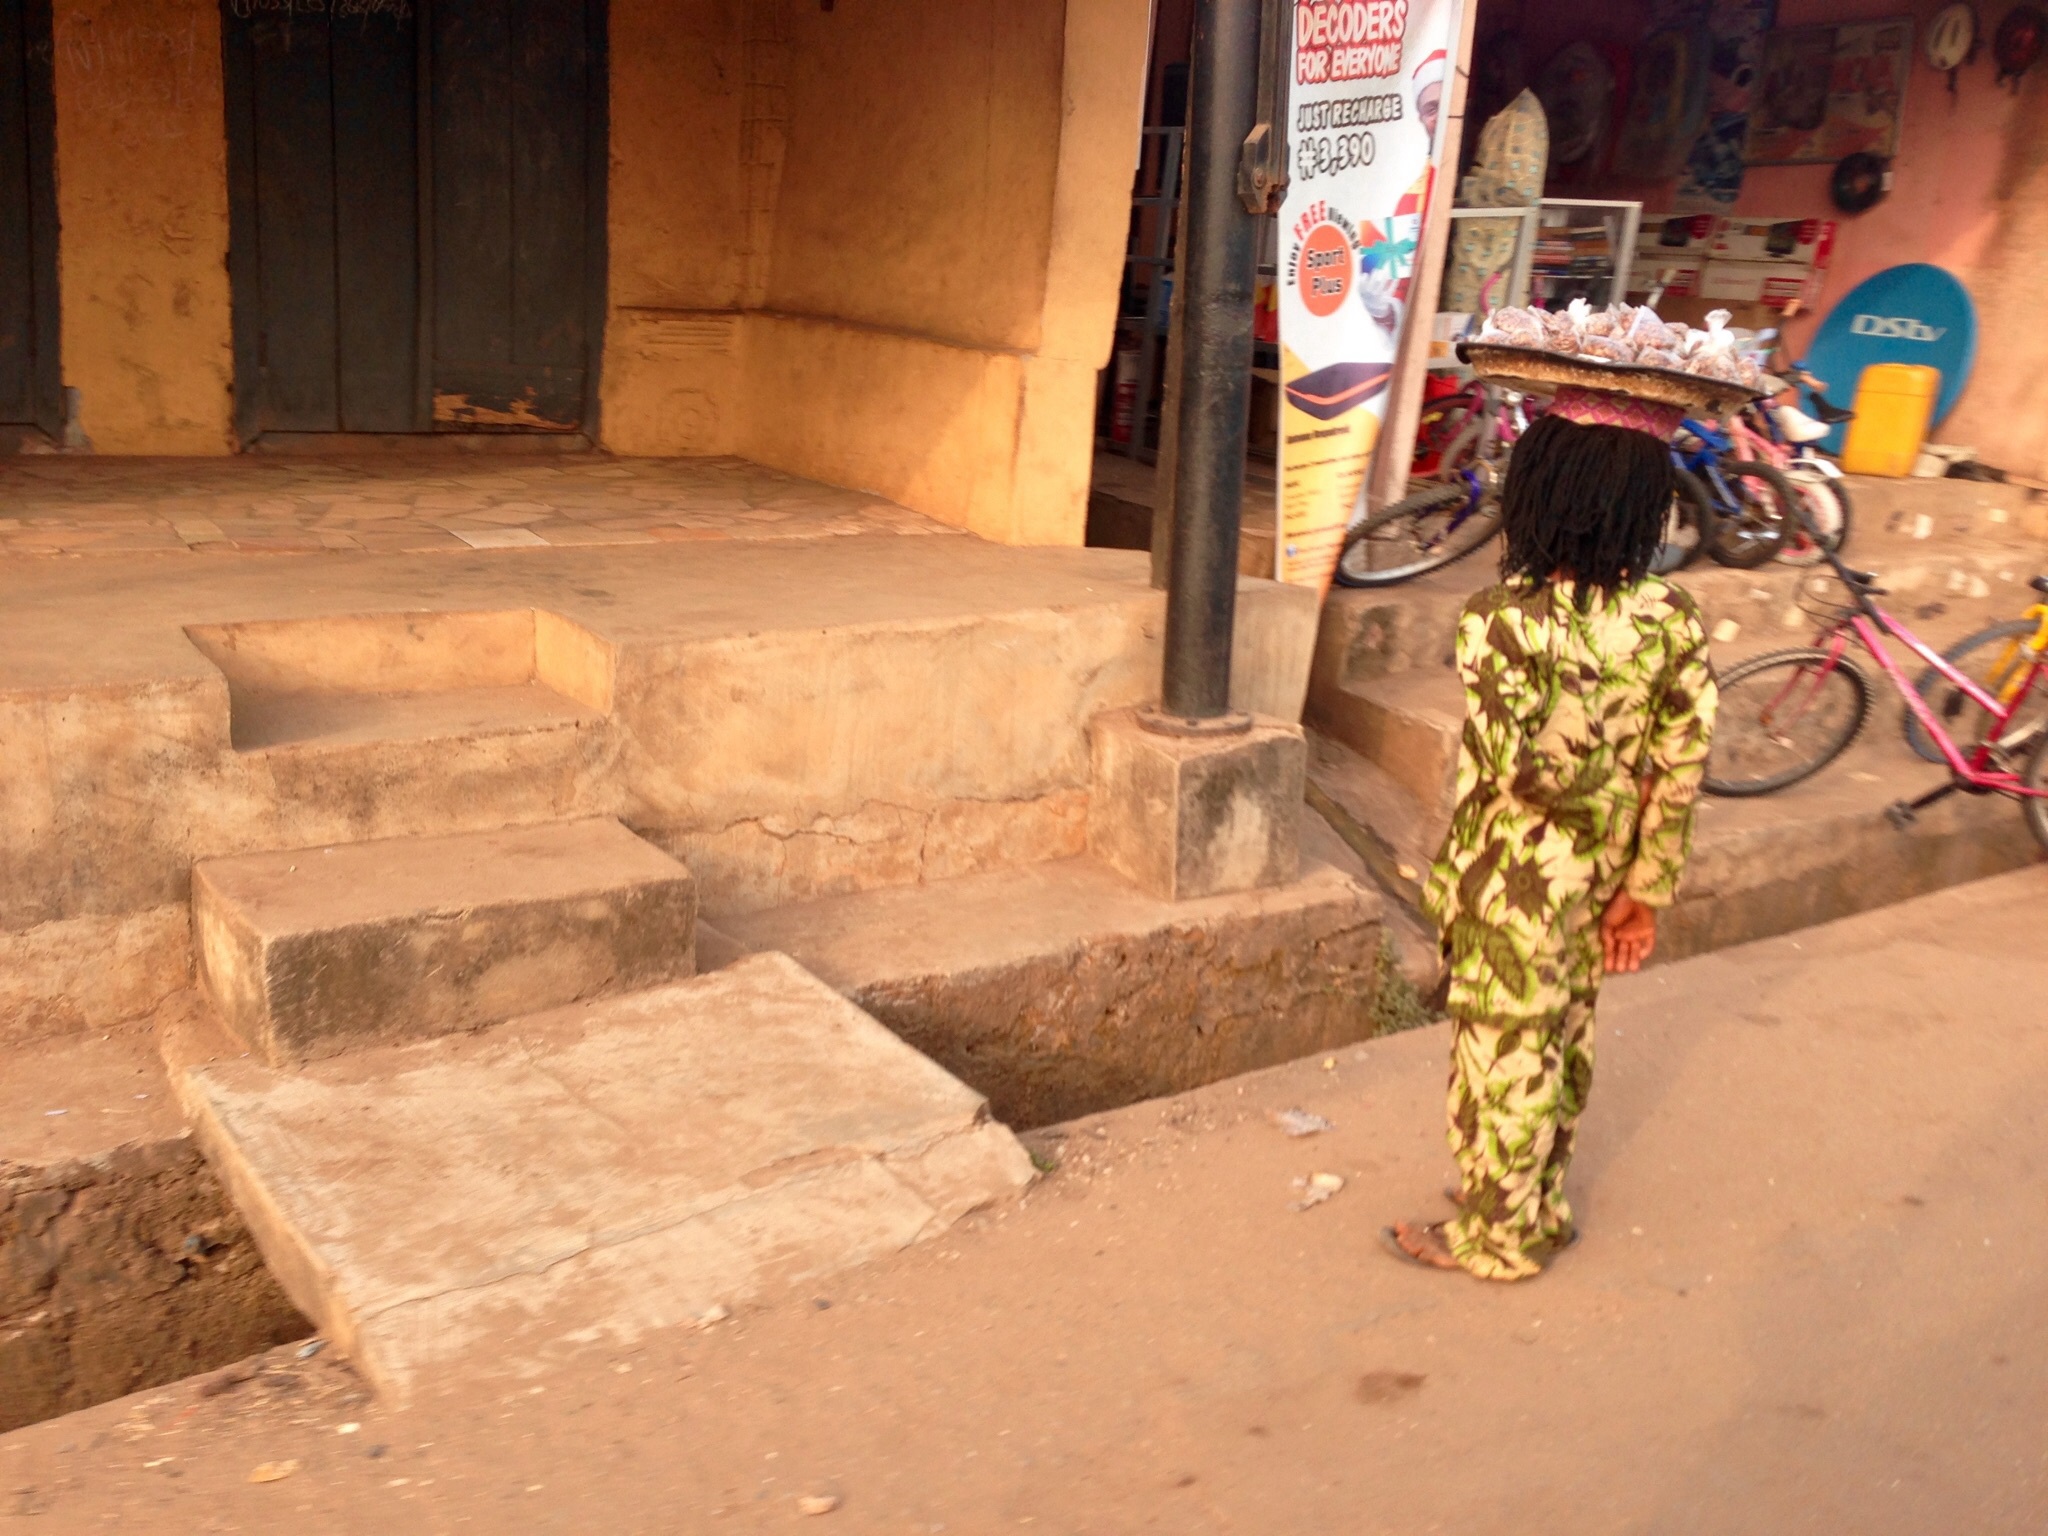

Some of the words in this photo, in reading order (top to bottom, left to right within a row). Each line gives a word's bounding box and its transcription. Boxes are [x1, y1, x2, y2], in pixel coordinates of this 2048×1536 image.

[1297, 1, 1408, 48] DECODERS
[1297, 50, 1329, 84] FOR
[1330, 43, 1402, 80] EVERYONE
[1298, 101, 1329, 132] JUST
[1331, 94, 1402, 128] RECHARGE
[1293, 200, 1326, 241] FREE
[1307, 247, 1345, 271] Sport
[1312, 277, 1343, 295] Plus
